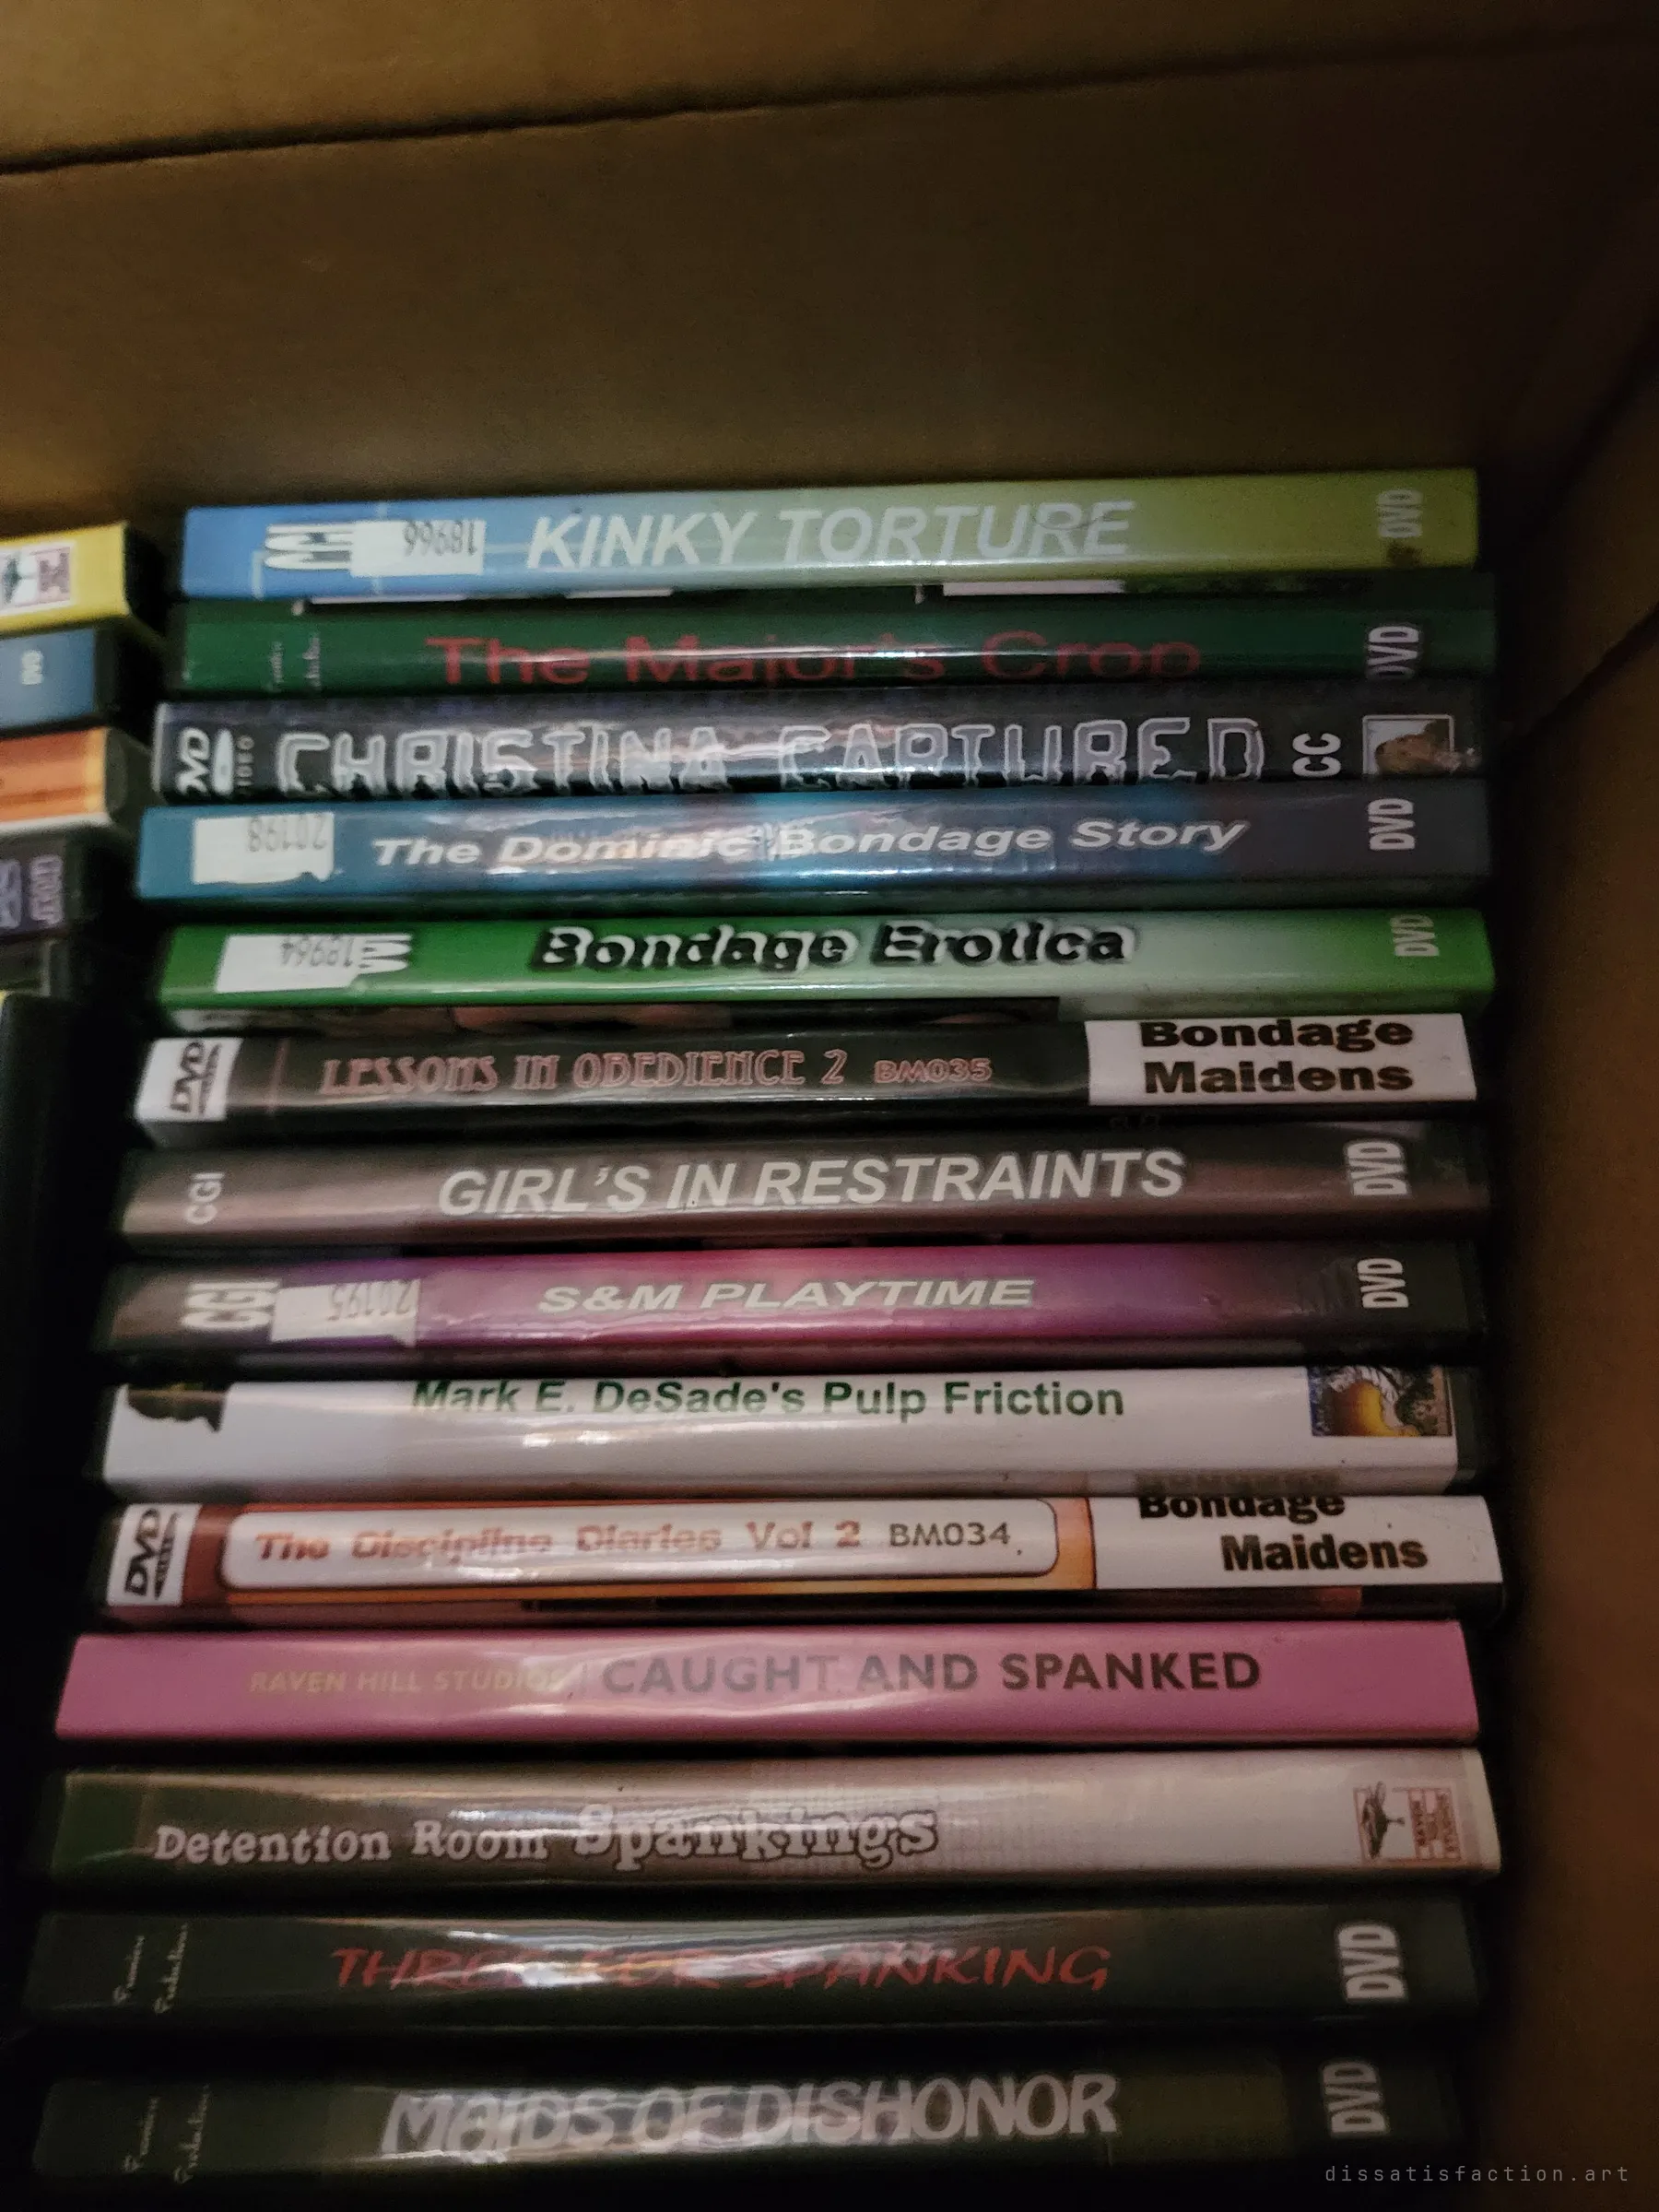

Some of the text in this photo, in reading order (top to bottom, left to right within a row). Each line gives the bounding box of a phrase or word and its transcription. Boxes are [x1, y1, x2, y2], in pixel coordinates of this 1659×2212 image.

[525, 500, 1135, 570] KINKY TORTURE
[1377, 488, 1423, 539] DVD
[426, 638, 591, 686] The
[981, 629, 1201, 680] Crop
[276, 717, 1265, 793] CHRISTINA CAPTURED
[373, 837, 479, 867] The
[774, 823, 1051, 859] Bondage
[1069, 818, 1248, 852] Story
[1367, 798, 1415, 851] DVD
[533, 920, 1136, 973] Bondage Erotica
[1390, 912, 1439, 957] DVD
[1139, 1019, 1414, 1053] Bondage
[170, 1041, 205, 1113] DVD
[320, 1048, 994, 1095] LESSONS IN OBEDIENCE 2 BM035
[1143, 1061, 1414, 1094] Maidens
[667, 1161, 737, 1209] IN
[754, 1147, 1185, 1206] RESTRAINTS
[1347, 1139, 1409, 1195] DVD
[184, 1171, 225, 1226] CGI
[536, 1277, 1035, 1314] S&M PLAYTIME
[1357, 1257, 1409, 1310] DVD
[410, 1380, 1124, 1422] Mark E. DeSade's Pulp Friction
[124, 1508, 160, 1596] DVD
[255, 1533, 329, 1560] The
[835, 1521, 862, 1547] 2
[889, 1521, 1011, 1547] BM034
[1222, 1534, 1429, 1571] Maidens
[251, 1671, 347, 1694] RAVEN
[358, 1670, 421, 1692] HILL
[602, 1652, 1261, 1694] CAUGHT AND SPANKED
[153, 1802, 939, 1869] Detention Room Spankings
[741, 1943, 1112, 1991] SPANKING
[1335, 1922, 1407, 2002] DVD
[745, 2074, 1119, 2147] DISHONOR
[1322, 2061, 1390, 2136] DVD
